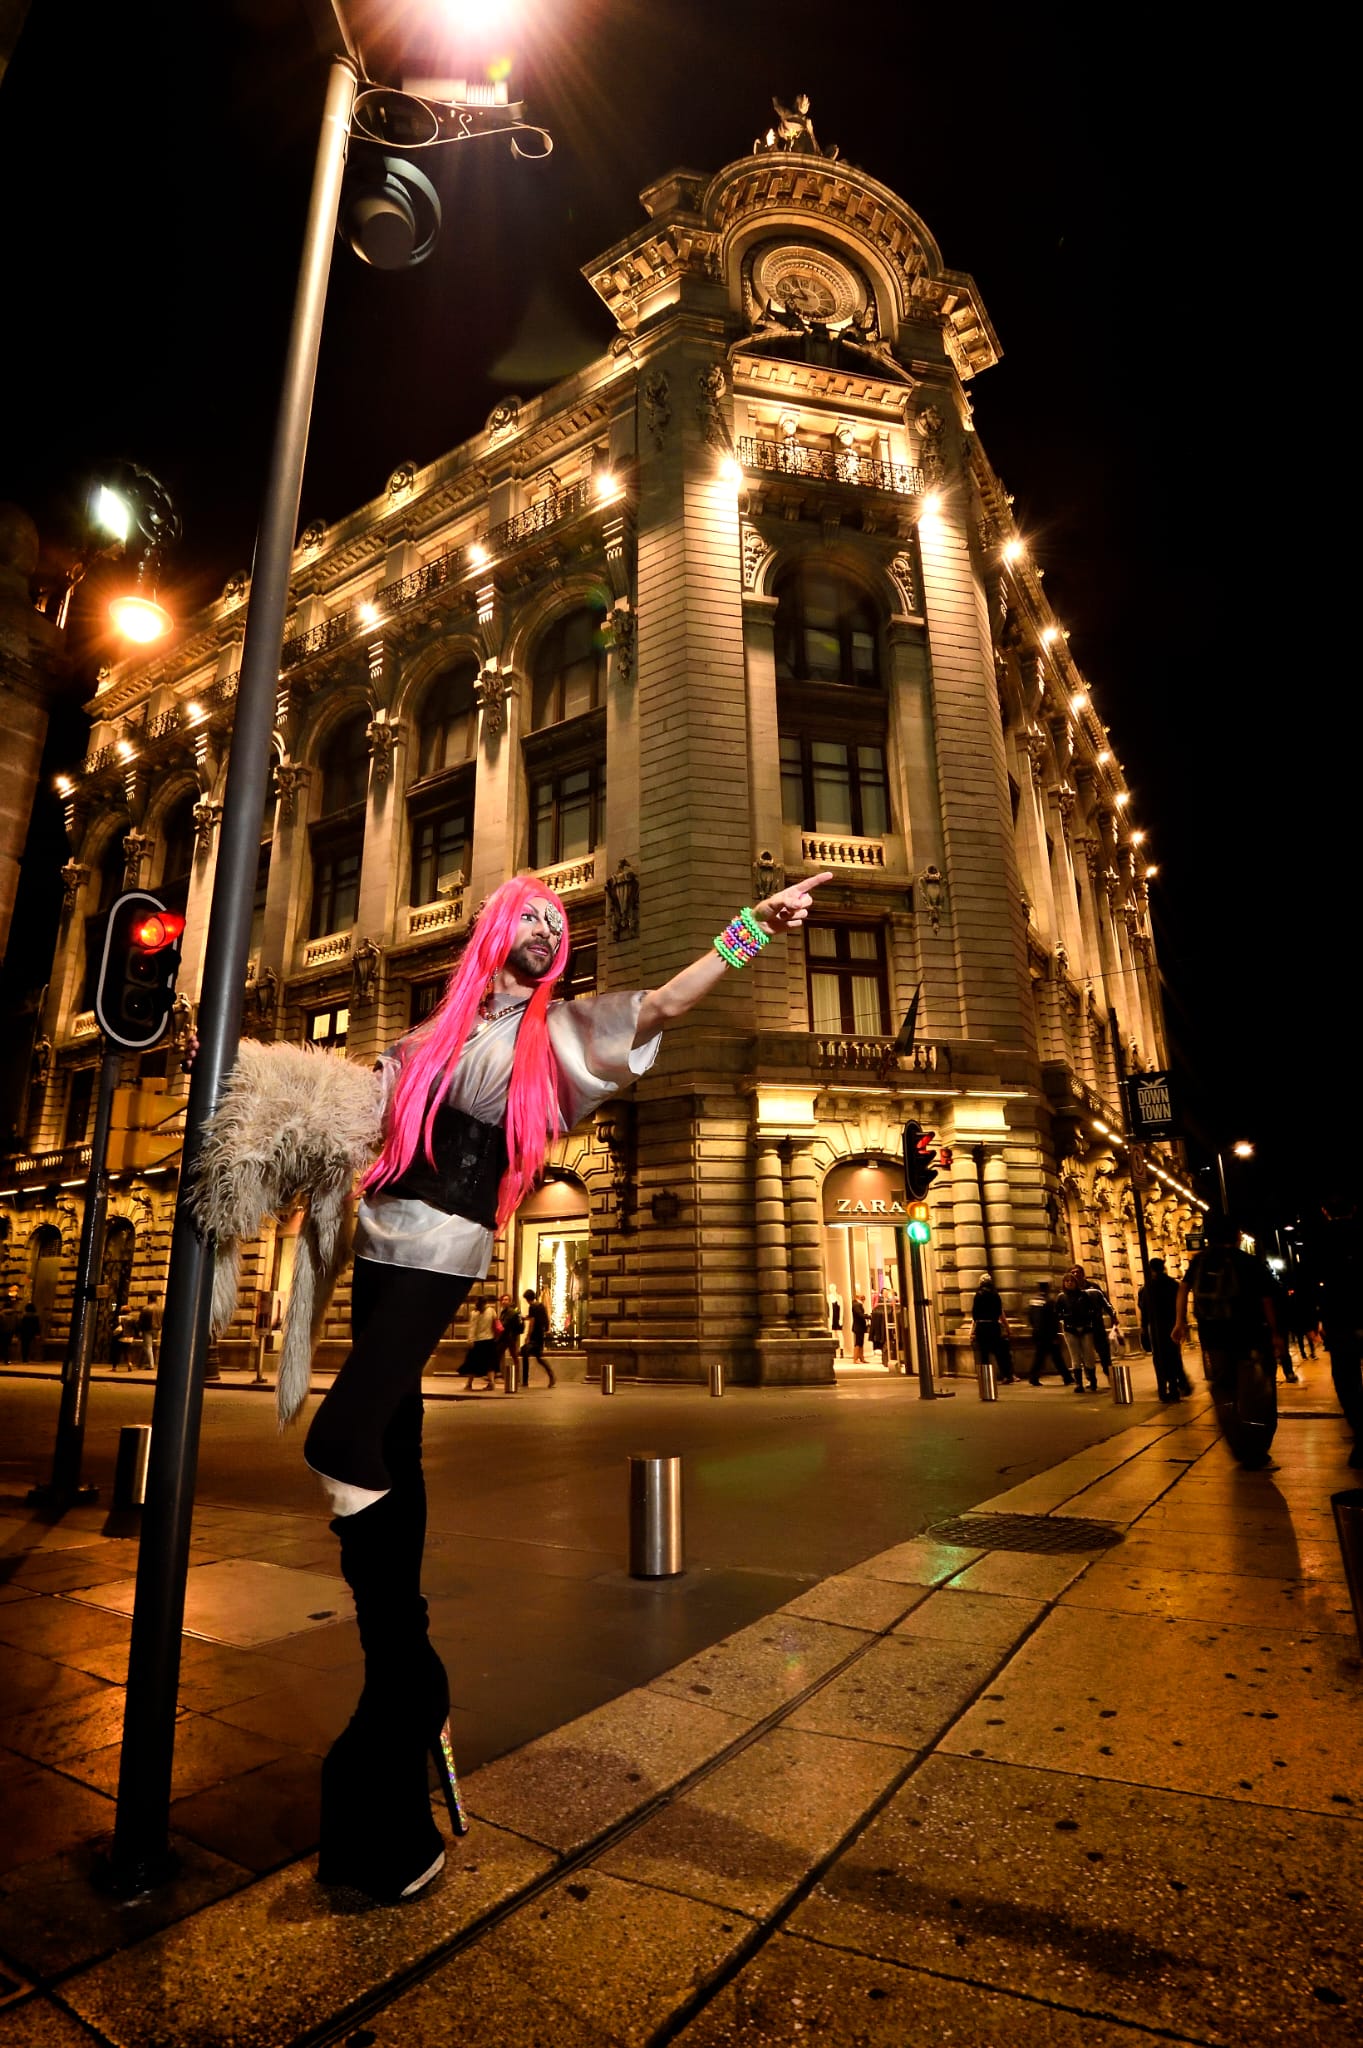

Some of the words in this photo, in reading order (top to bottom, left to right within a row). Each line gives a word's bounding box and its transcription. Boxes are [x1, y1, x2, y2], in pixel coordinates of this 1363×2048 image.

[1137, 1087, 1170, 1106] DOWN
[1139, 1103, 1172, 1121] TOWN
[837, 1199, 906, 1213] ZARA
